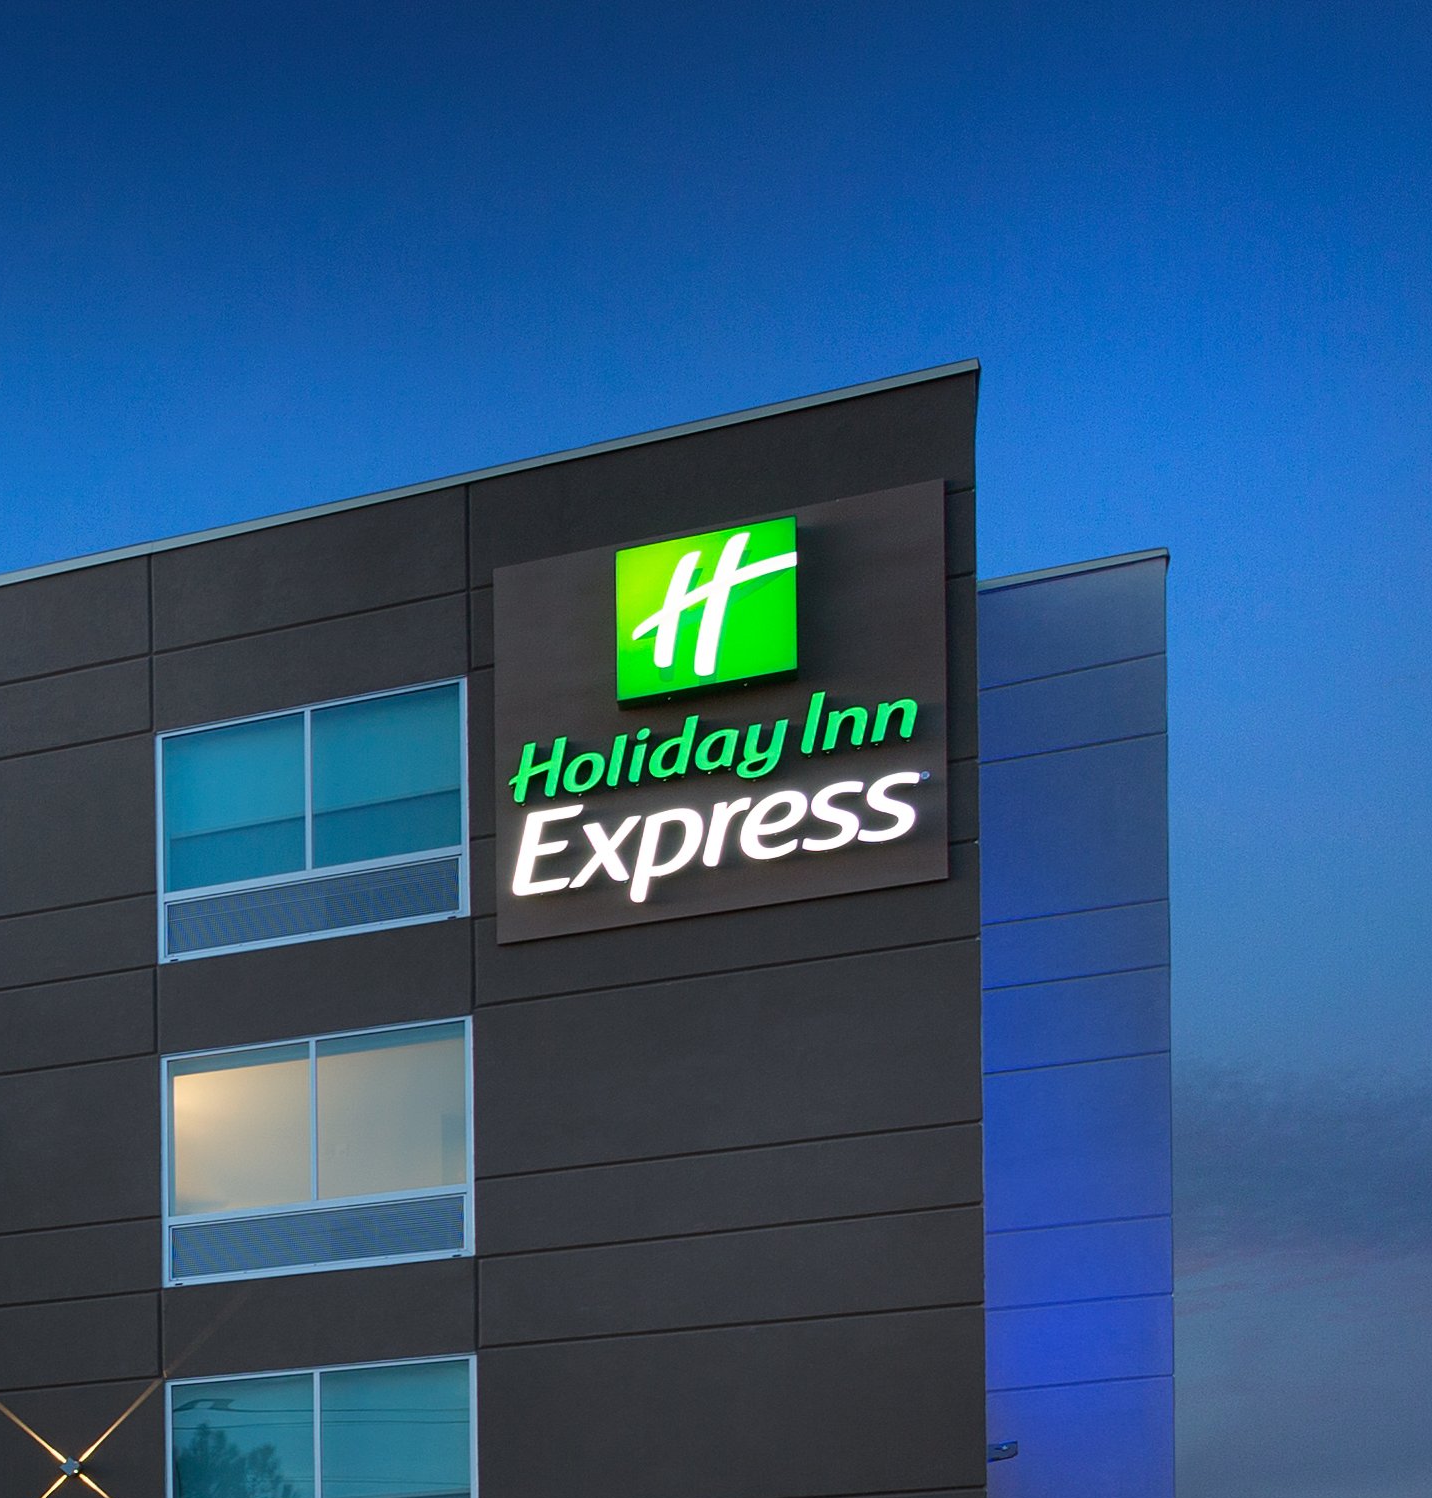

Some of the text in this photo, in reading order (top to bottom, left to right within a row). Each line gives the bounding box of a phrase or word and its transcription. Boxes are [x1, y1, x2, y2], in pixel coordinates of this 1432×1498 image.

[508, 691, 918, 804] Holiday Inn
[512, 771, 920, 903] Express
